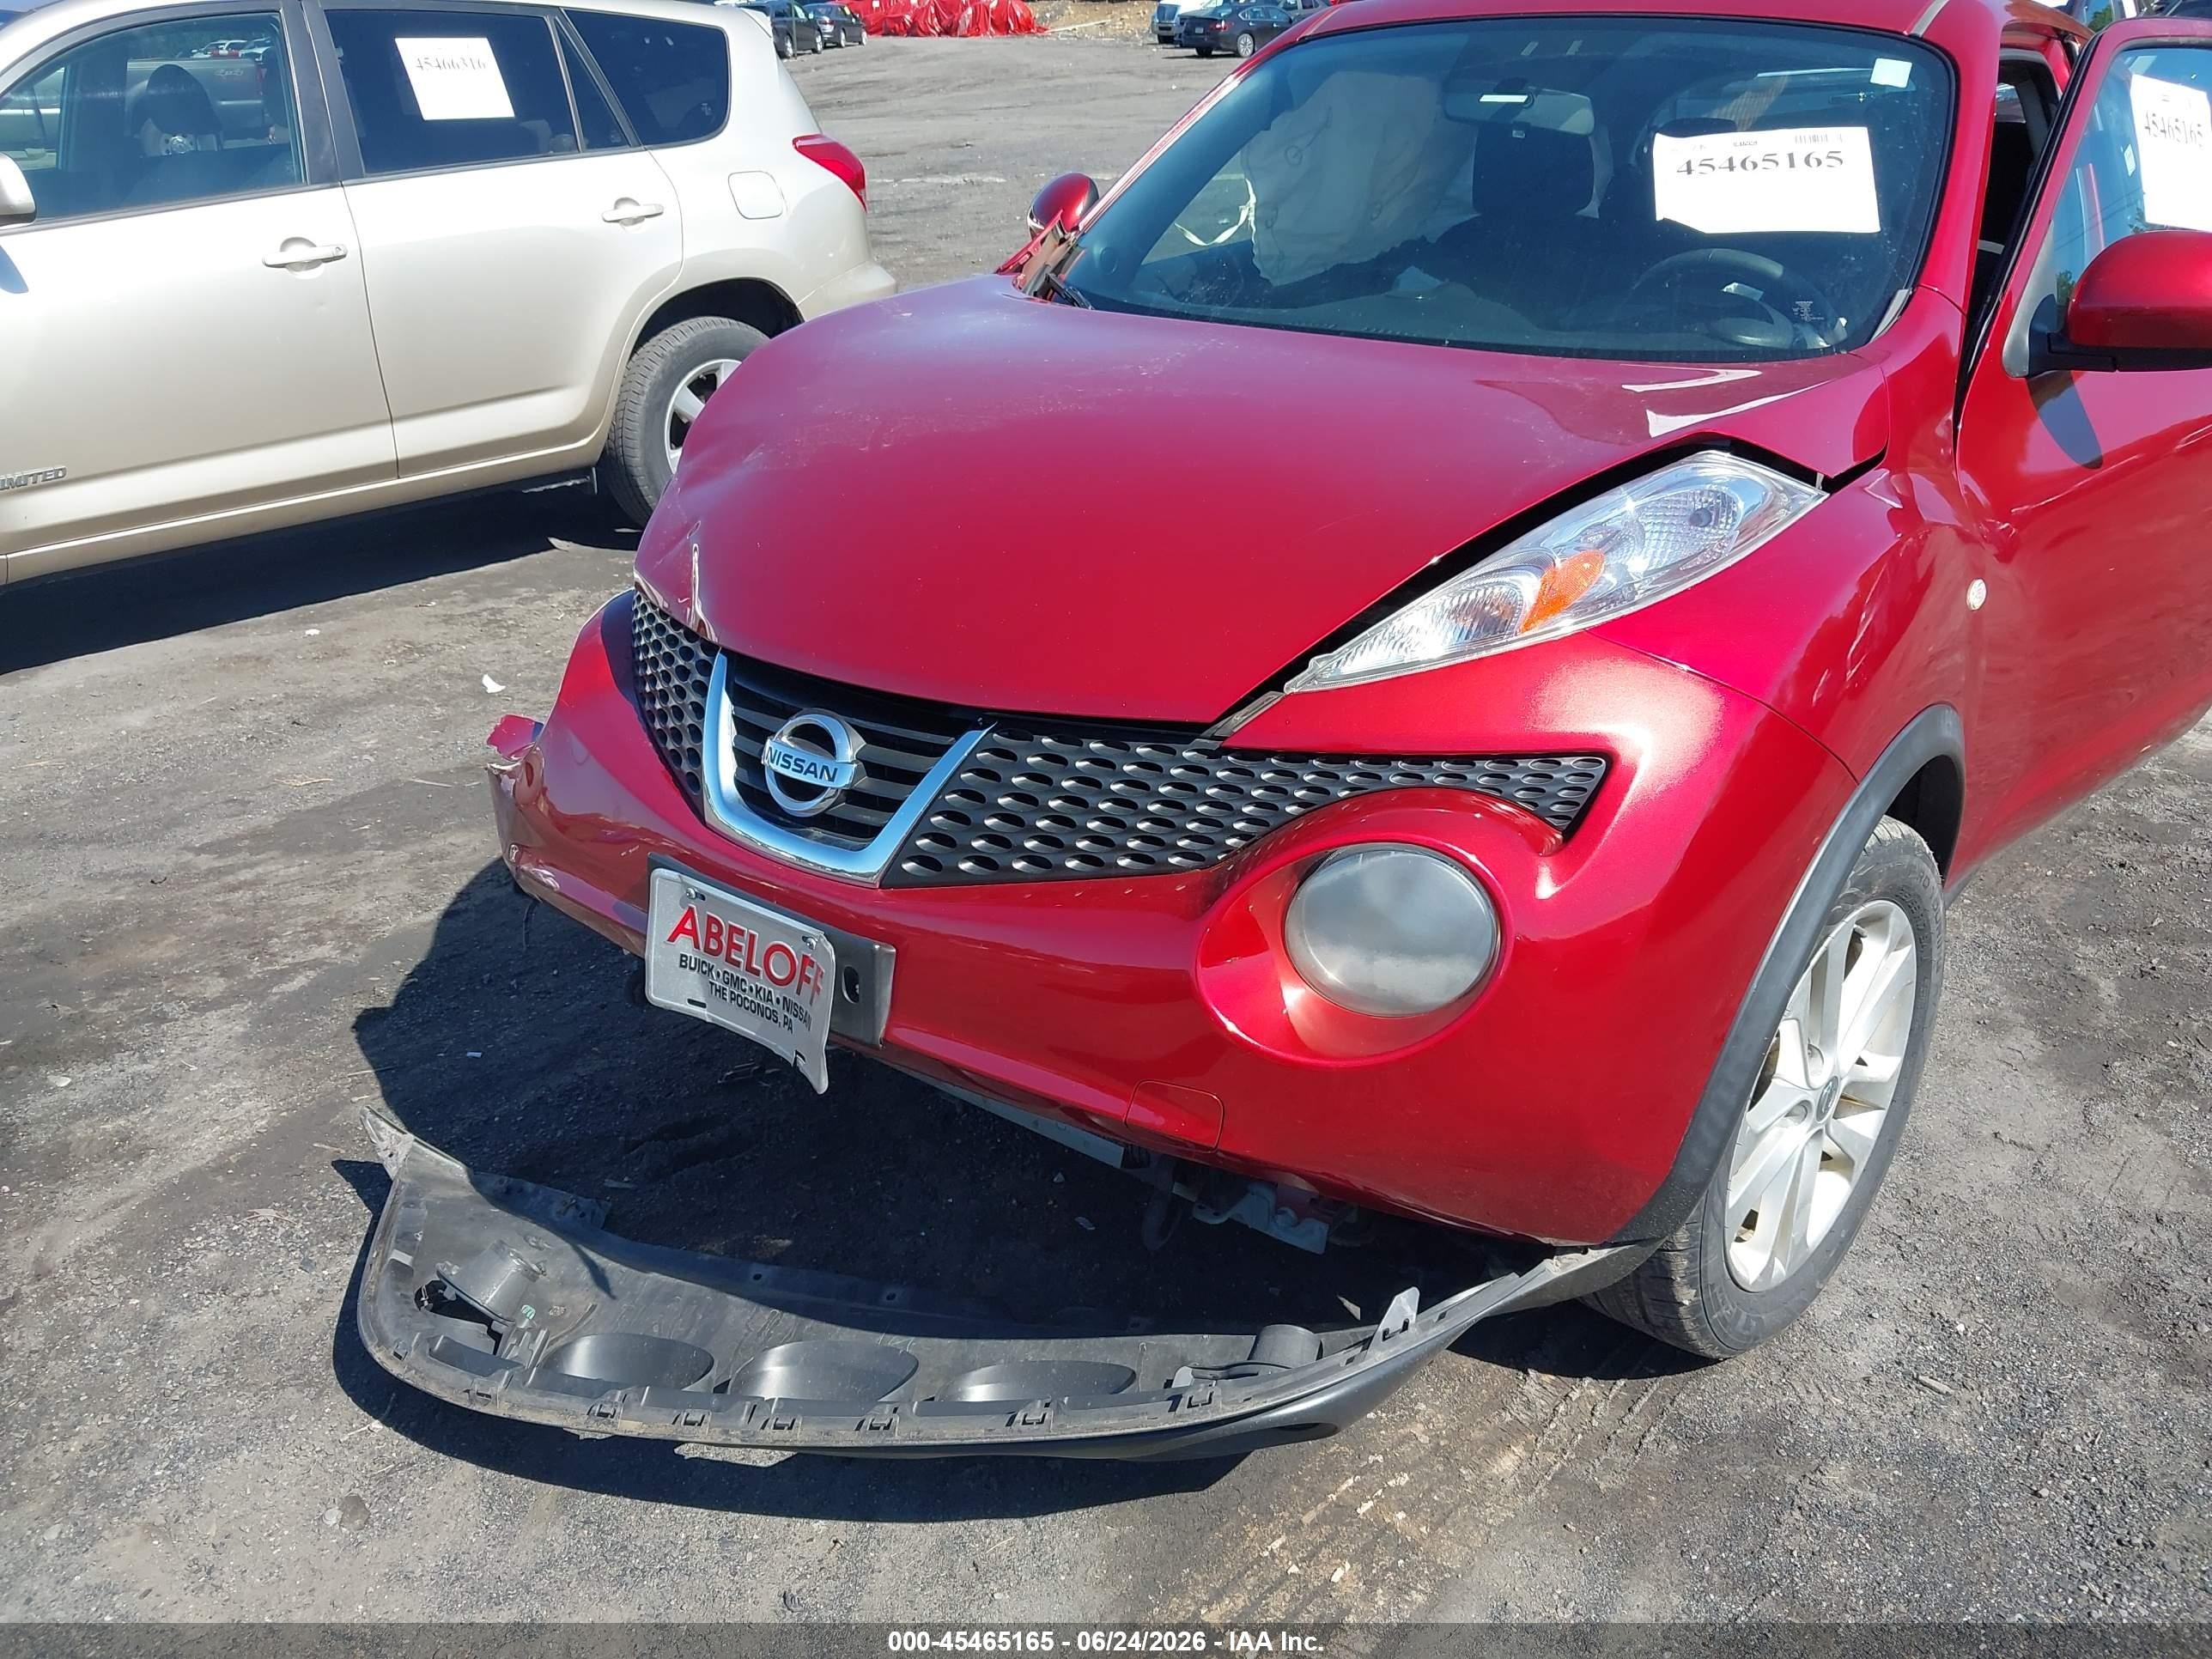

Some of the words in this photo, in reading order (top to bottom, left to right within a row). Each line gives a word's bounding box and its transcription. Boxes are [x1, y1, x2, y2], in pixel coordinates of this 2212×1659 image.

[1676, 150, 1844, 176] 45465165
[0, 466, 67, 490] IMITED
[765, 745, 839, 782] NISSAN
[666, 904, 824, 1006] ABELOFF
[708, 980, 731, 1001] THE
[782, 1015, 794, 1035] PA
